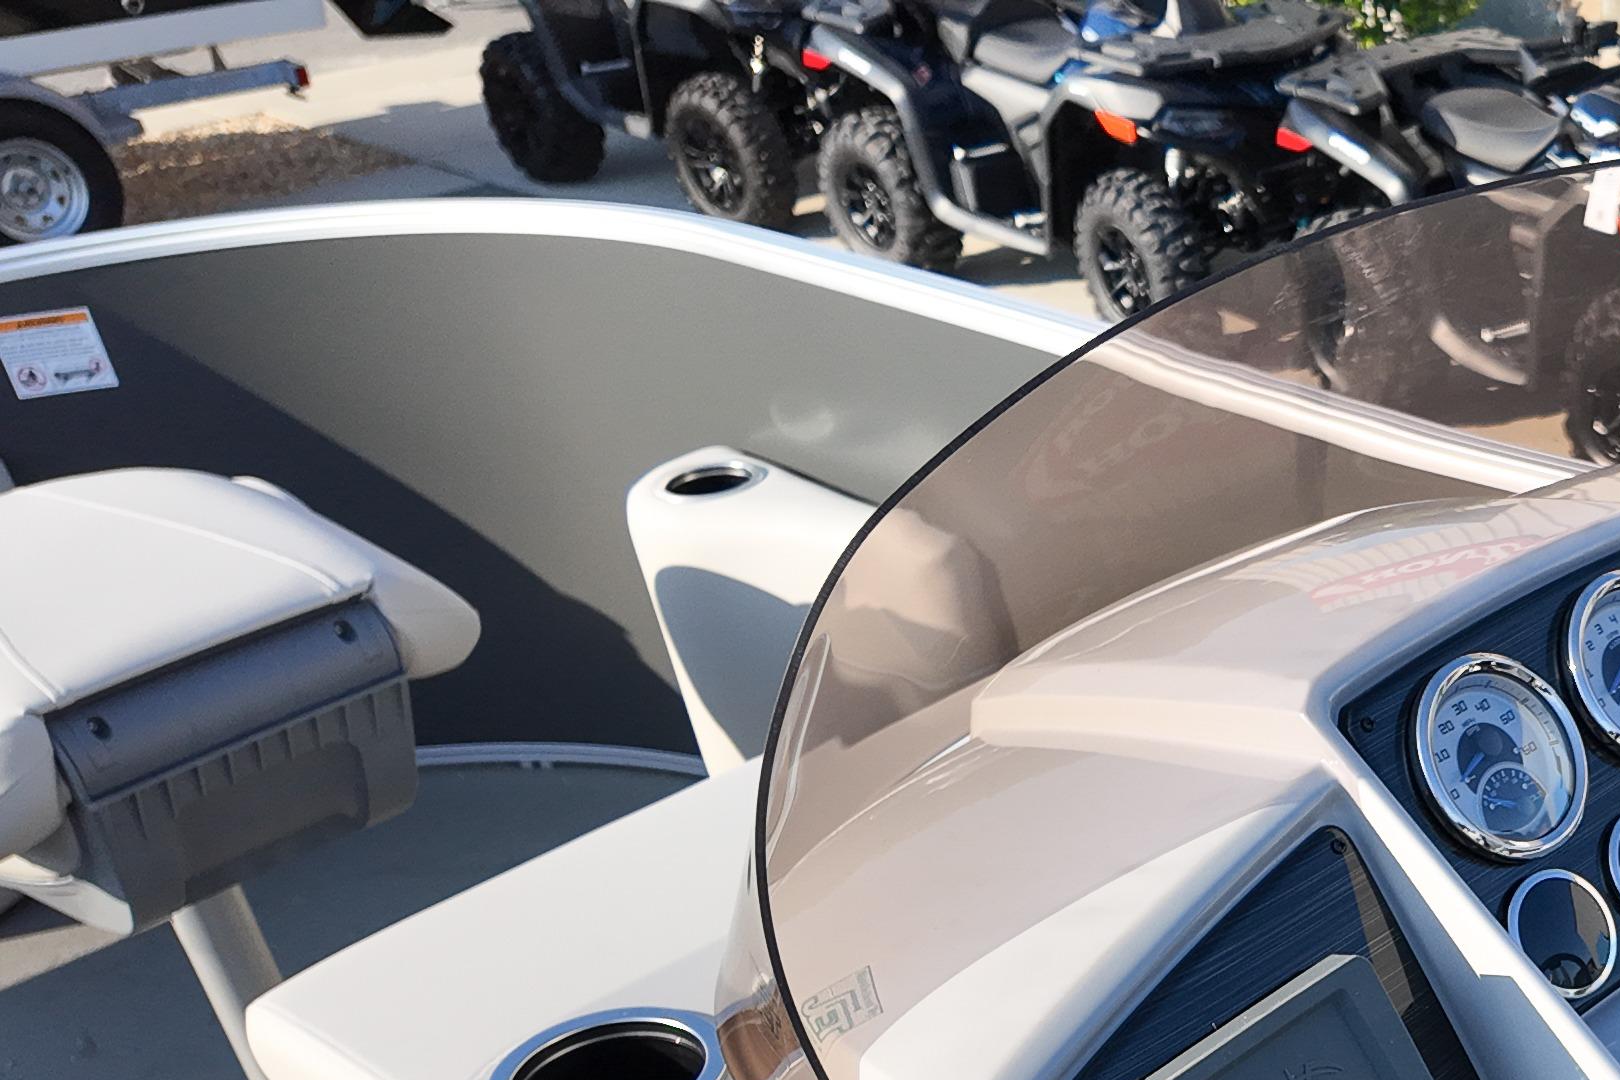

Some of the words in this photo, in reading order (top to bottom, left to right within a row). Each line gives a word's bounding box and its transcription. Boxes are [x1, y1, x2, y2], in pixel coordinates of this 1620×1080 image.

[1594, 623, 1604, 636] 3
[1585, 640, 1596, 651] 2
[1451, 699, 1468, 716] 30
[1474, 698, 1491, 712] 40
[1499, 709, 1516, 726] 50
[1438, 719, 1456, 735] 20
[1521, 740, 1537, 755] 60
[1434, 748, 1450, 763] 10
[1450, 788, 1460, 800] 0
